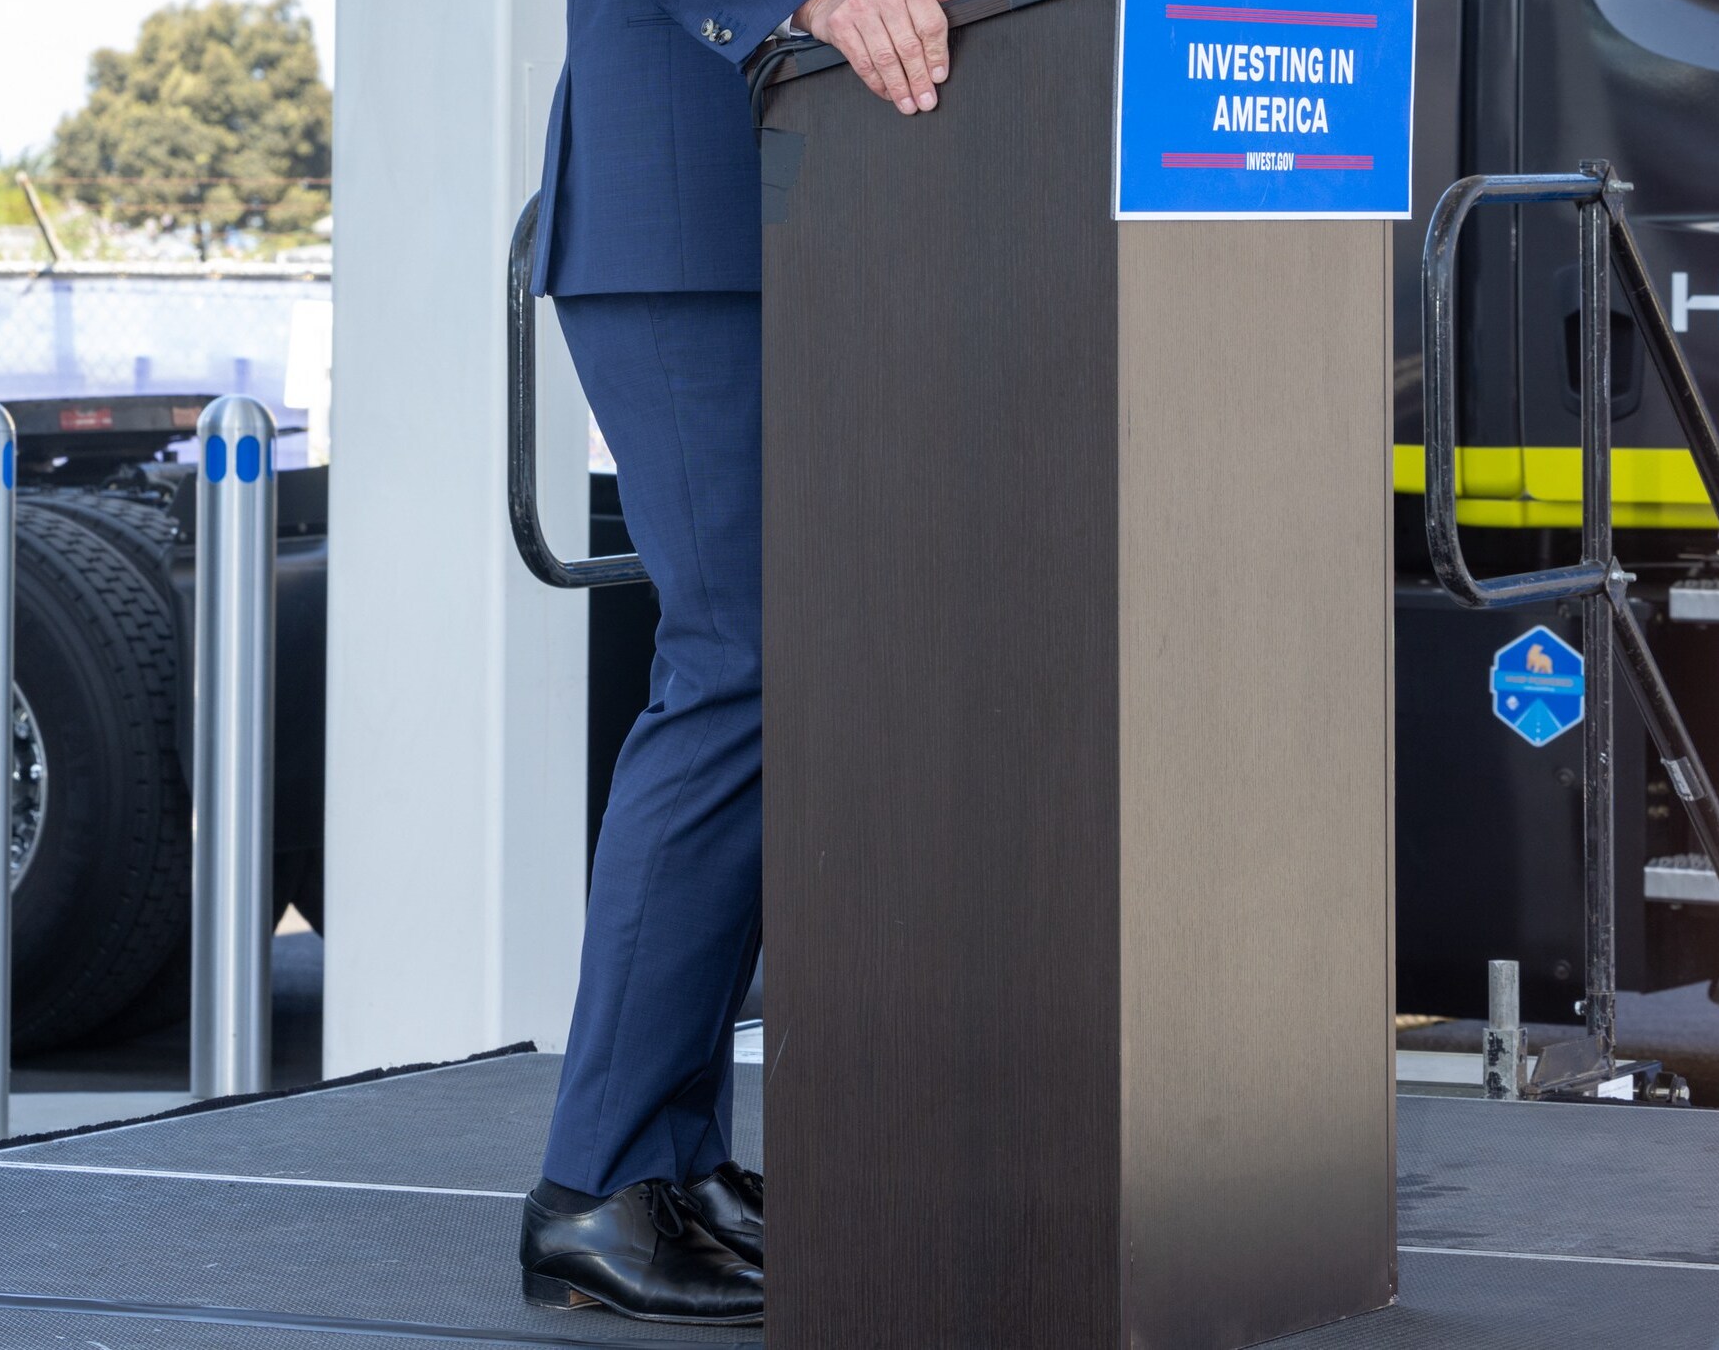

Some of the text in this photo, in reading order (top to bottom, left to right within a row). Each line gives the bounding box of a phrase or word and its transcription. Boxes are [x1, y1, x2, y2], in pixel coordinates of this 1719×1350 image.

[1188, 42, 1354, 85] INVESTING IN
[1212, 95, 1329, 134] AMERICA
[1246, 151, 1294, 171] INVEST.GOV
